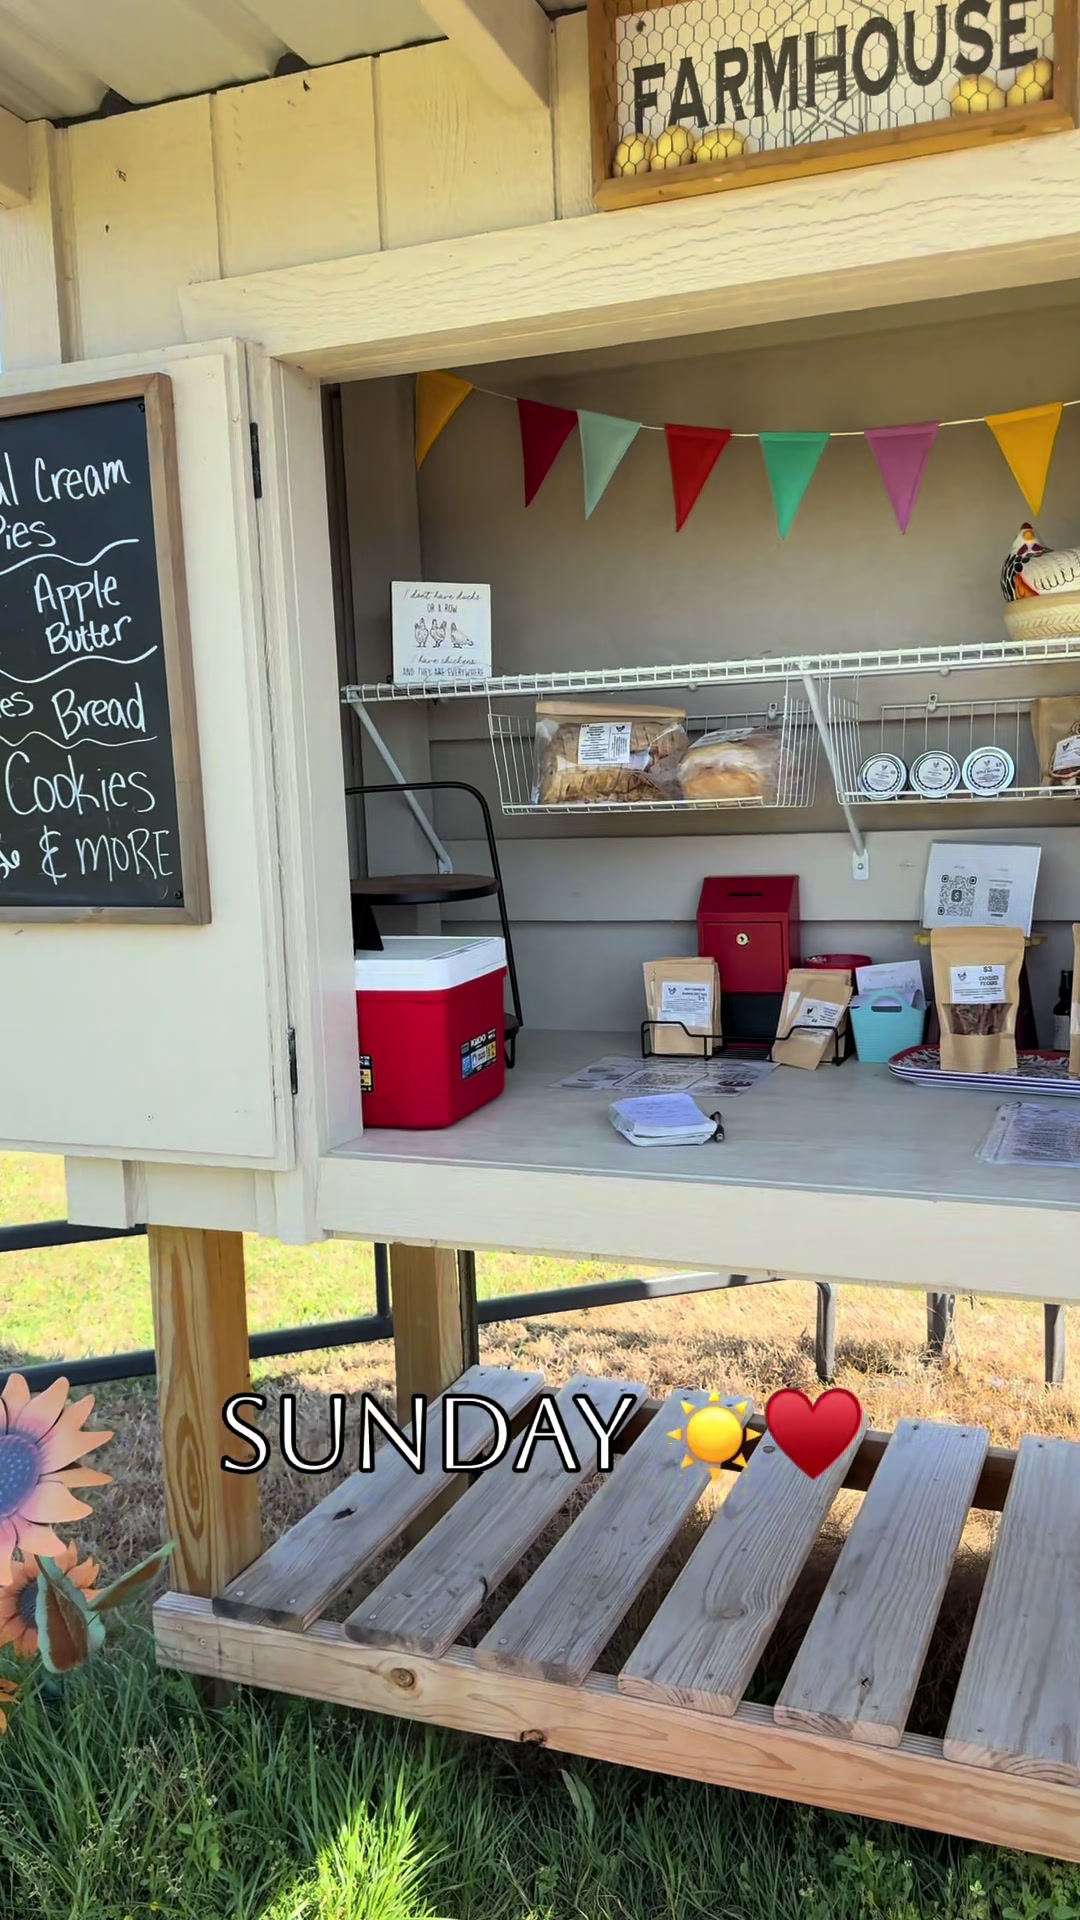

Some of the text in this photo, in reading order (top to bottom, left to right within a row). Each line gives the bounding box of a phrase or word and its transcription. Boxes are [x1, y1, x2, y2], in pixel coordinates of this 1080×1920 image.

[632, 0, 1039, 134] FARMHOUSE
[35, 457, 131, 503] Cream
[34, 569, 121, 626] Apple
[433, 590, 454, 600] have
[456, 590, 480, 601] ducks
[445, 604, 458, 614] ROW
[45, 615, 132, 654] Butter
[418, 655, 438, 664] have
[441, 655, 476, 665] chickens
[51, 682, 146, 740] Bread
[5, 751, 156, 815] Cookies
